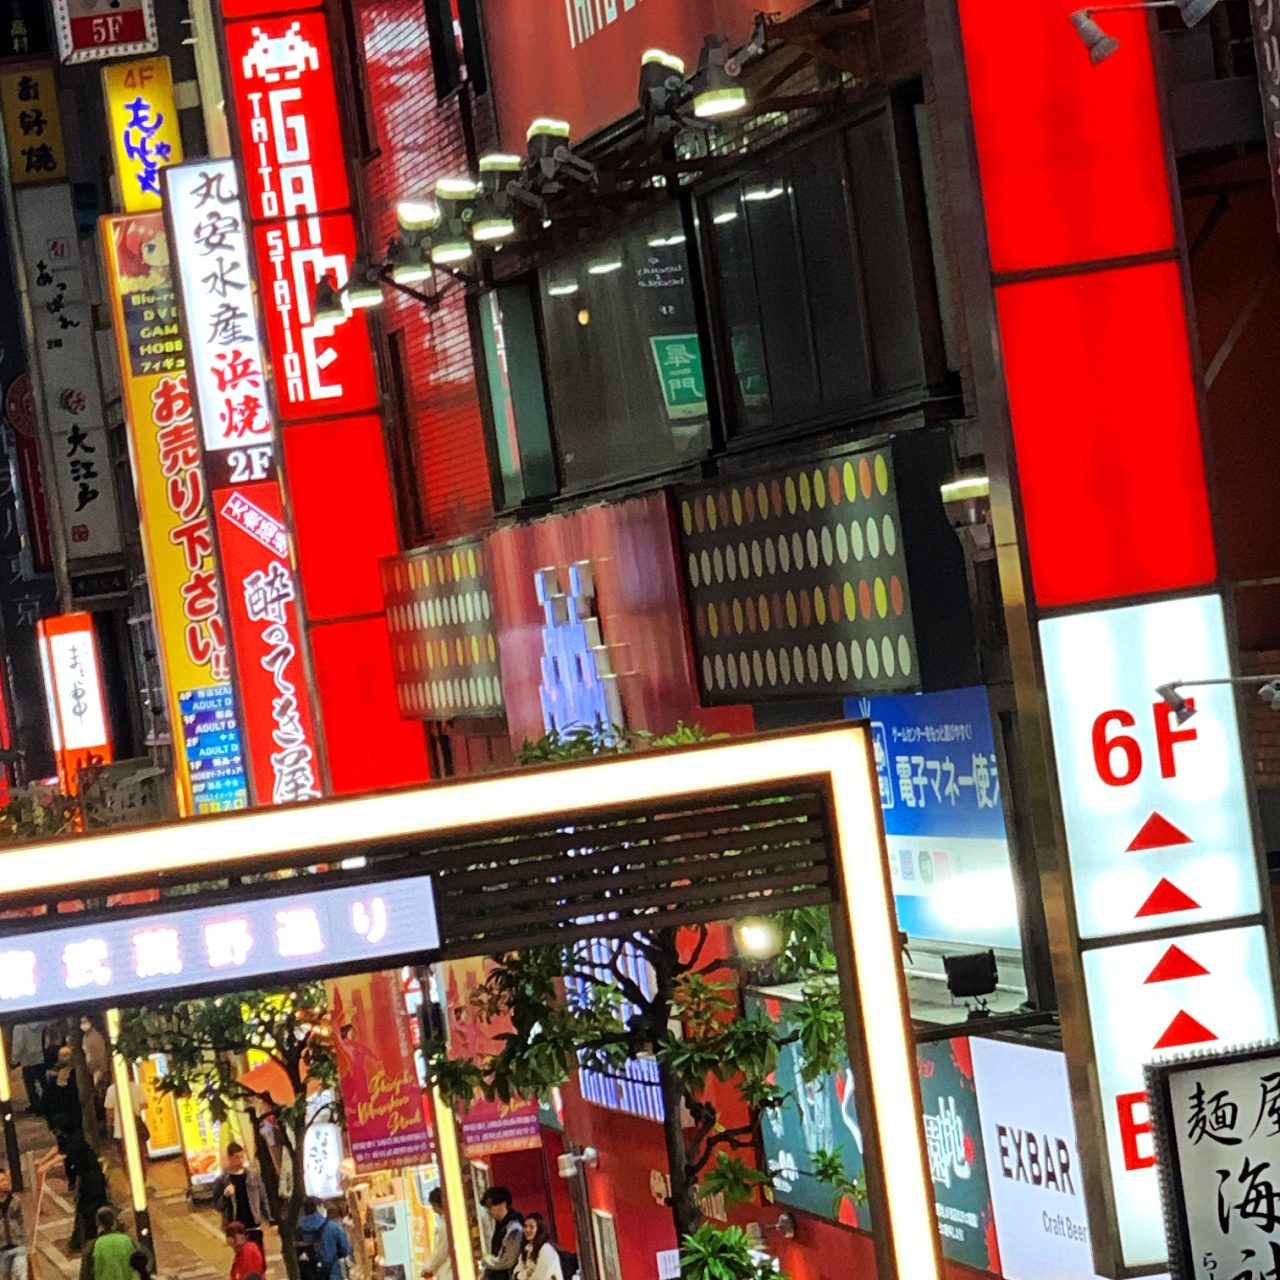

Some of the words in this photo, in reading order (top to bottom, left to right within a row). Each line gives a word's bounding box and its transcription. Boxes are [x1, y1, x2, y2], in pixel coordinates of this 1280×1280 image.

[92, 16, 124, 43] 5F
[124, 67, 154, 90] 4F
[248, 92, 278, 217] TAITO
[266, 229, 305, 403] STATION
[269, 87, 349, 400] GAME
[228, 449, 273, 482] 2F
[1092, 697, 1197, 786] 6F
[997, 1124, 1075, 1195] EXBAR
[1042, 1210, 1067, 1236] Craft
